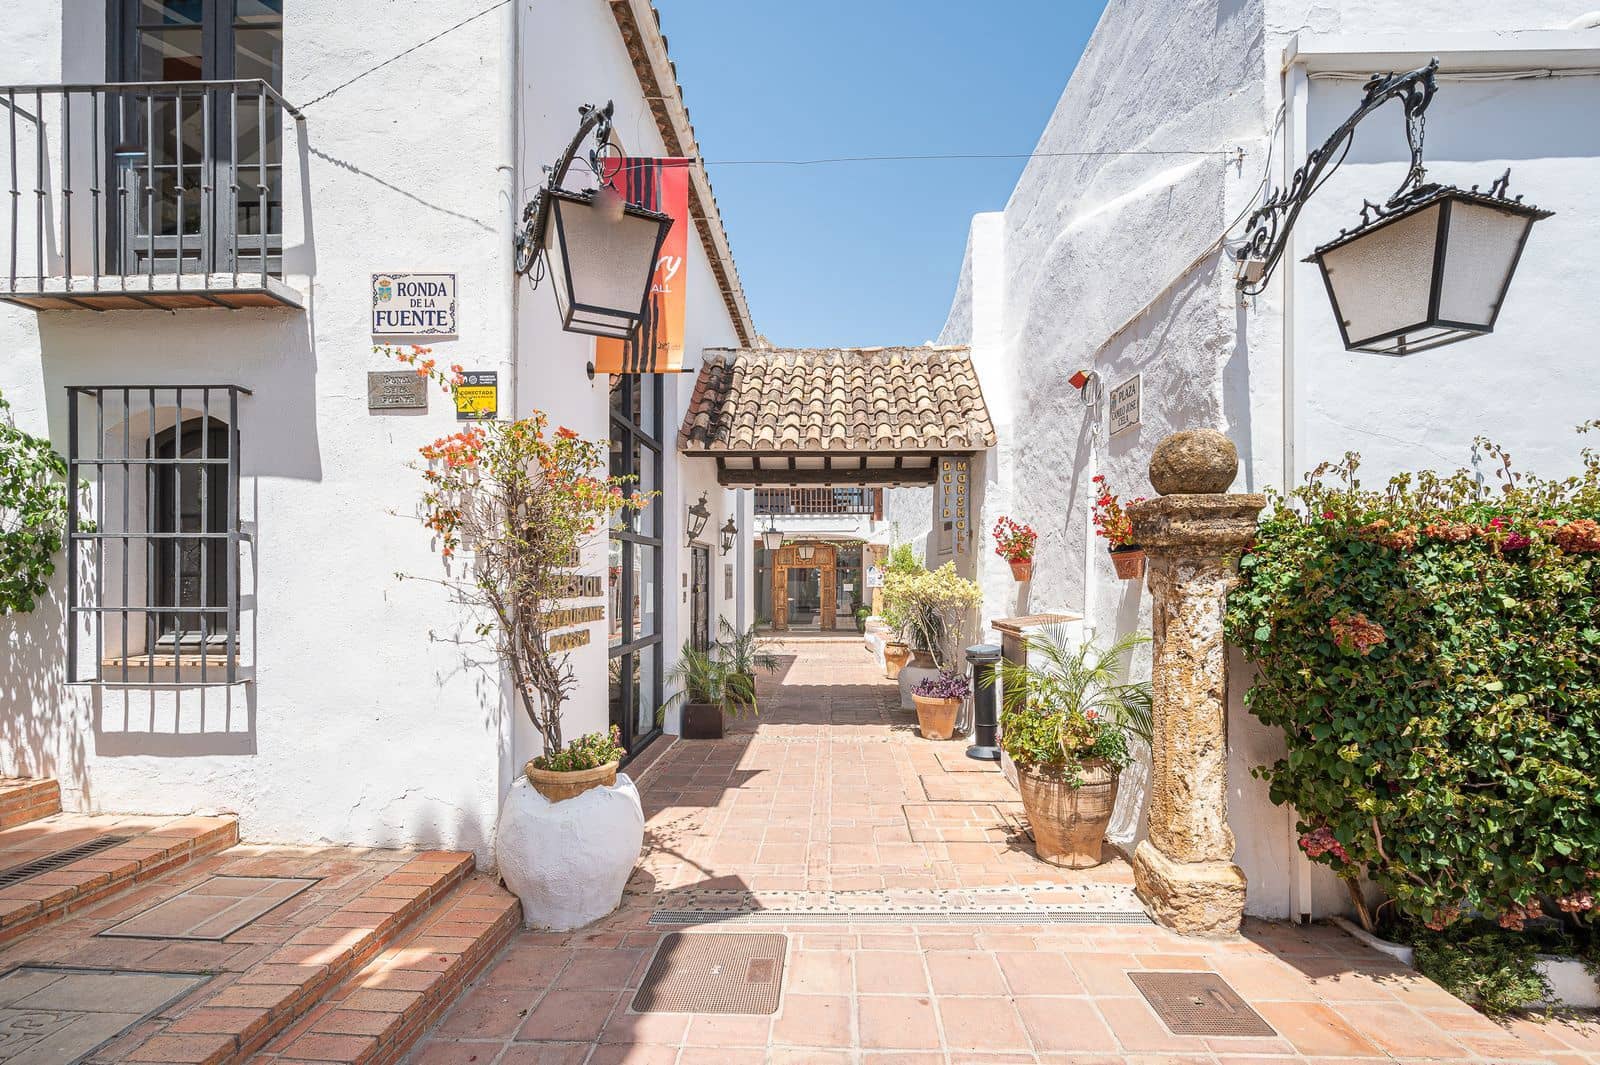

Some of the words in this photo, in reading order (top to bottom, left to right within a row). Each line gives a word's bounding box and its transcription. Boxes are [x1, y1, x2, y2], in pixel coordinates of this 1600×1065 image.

[397, 282, 447, 297] RONDA
[410, 298, 422, 308] DE
[424, 298, 435, 308] LA
[376, 310, 448, 327] FUENTE
[1118, 383, 1136, 403] PLAZA
